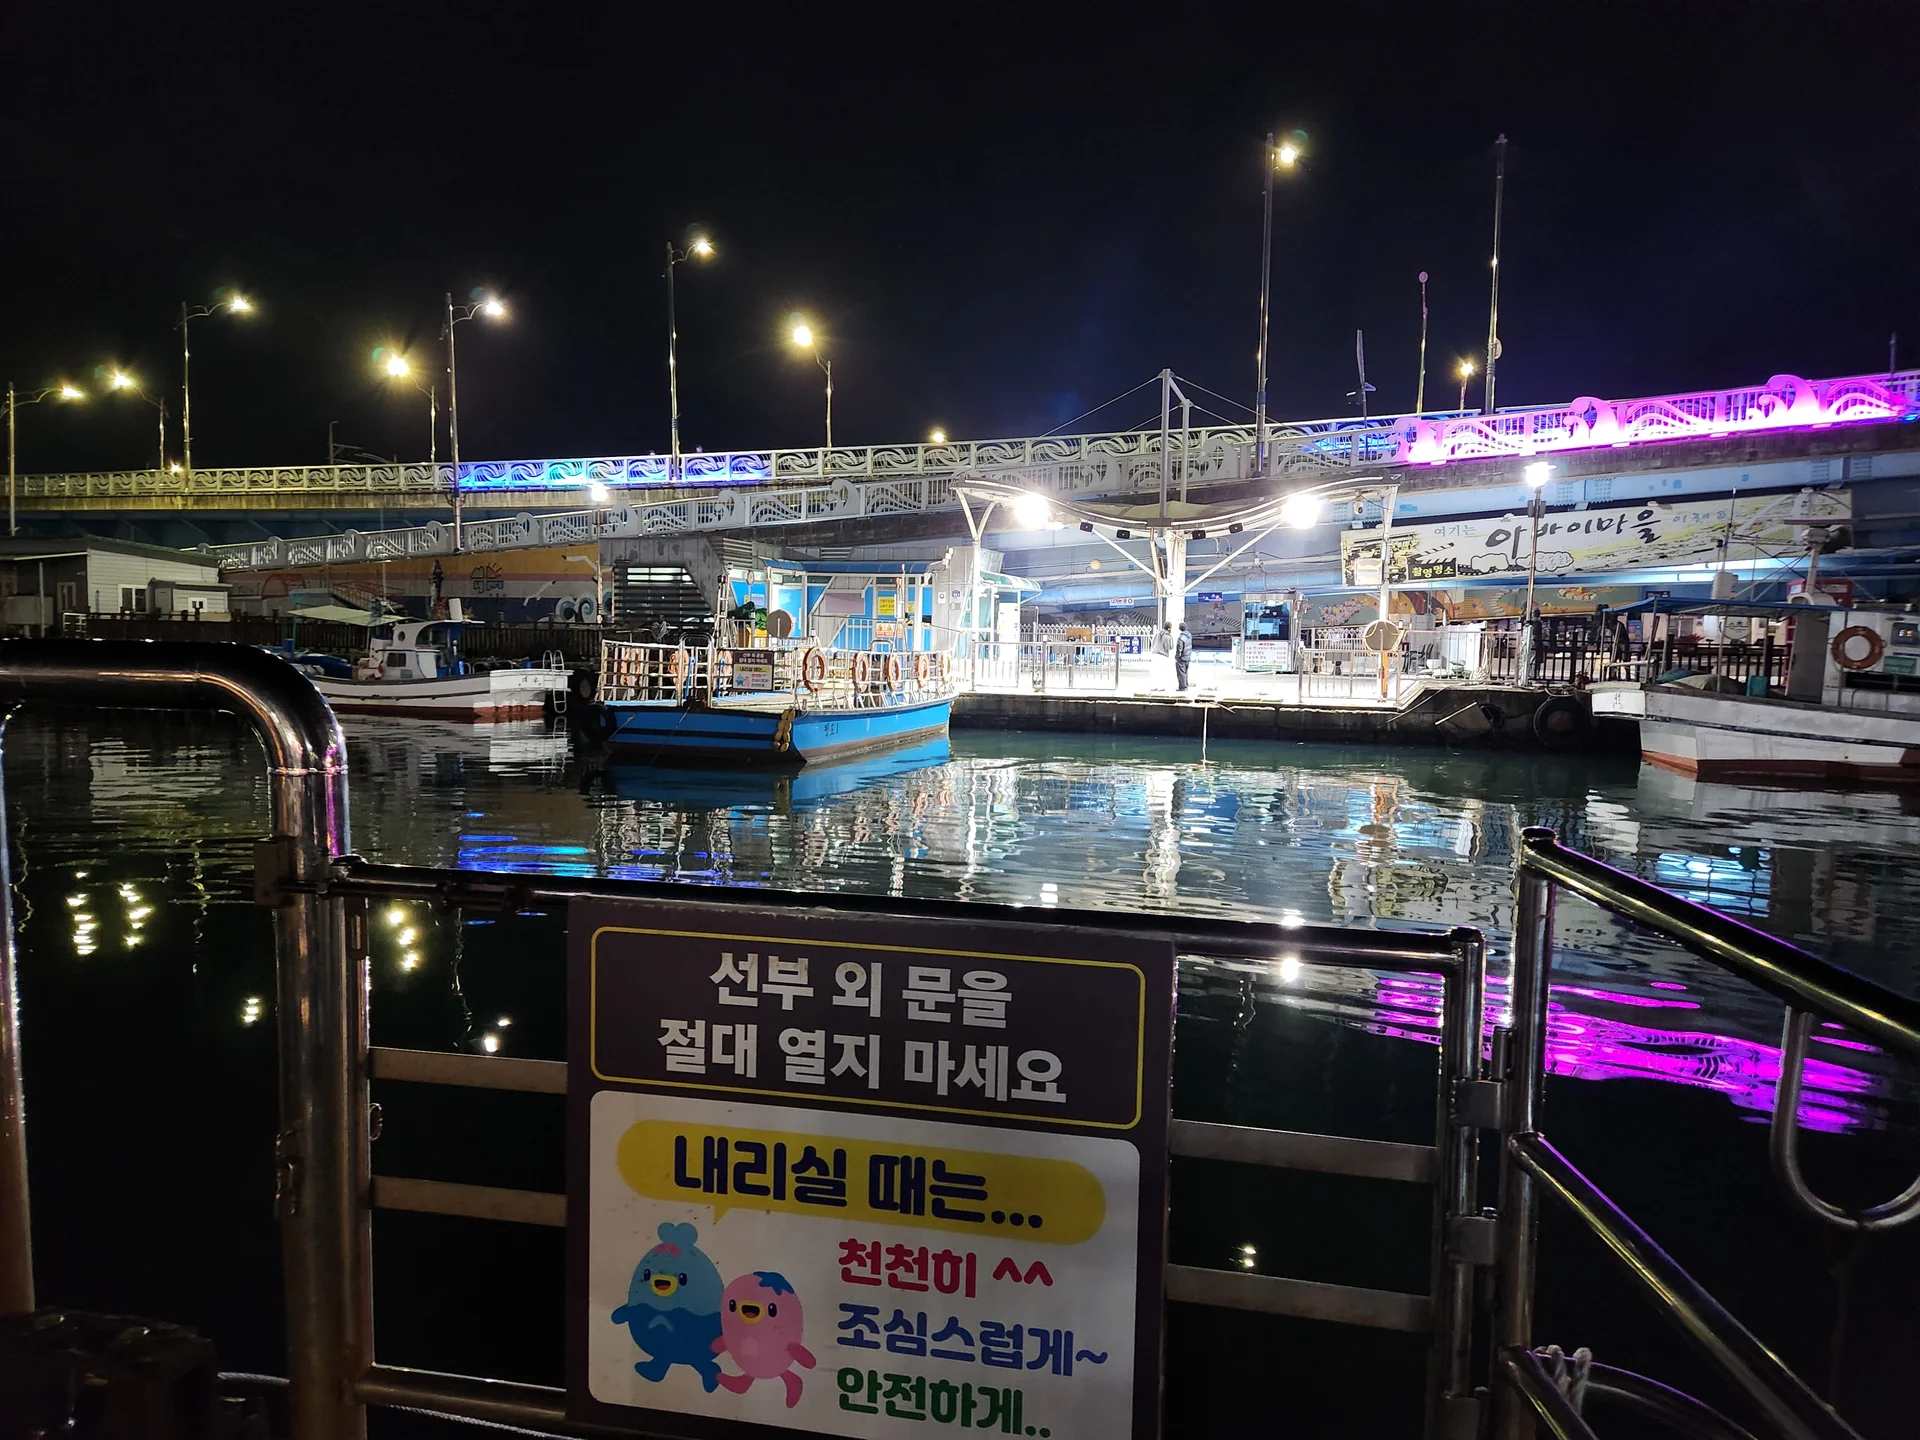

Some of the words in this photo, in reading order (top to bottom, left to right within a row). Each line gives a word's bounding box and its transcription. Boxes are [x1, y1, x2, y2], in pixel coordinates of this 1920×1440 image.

[1433, 524, 1477, 538] 여기는
[1485, 509, 1662, 559] 아바이마을
[1411, 564, 1455, 579] 촬영명소
[710, 952, 813, 1010] 선부
[832, 962, 882, 1018] 외
[902, 967, 1013, 1029] 문을
[657, 1018, 758, 1079] 절대
[779, 1028, 881, 1090] 열지
[904, 1040, 1067, 1104] 마세요
[673, 1134, 849, 1208] 내리실
[868, 1155, 1043, 1230] 때는...
[838, 1237, 977, 1299] 천천히
[836, 1302, 1109, 1377] 조심스럽게~
[836, 1367, 1052, 1440] 안전하게..
